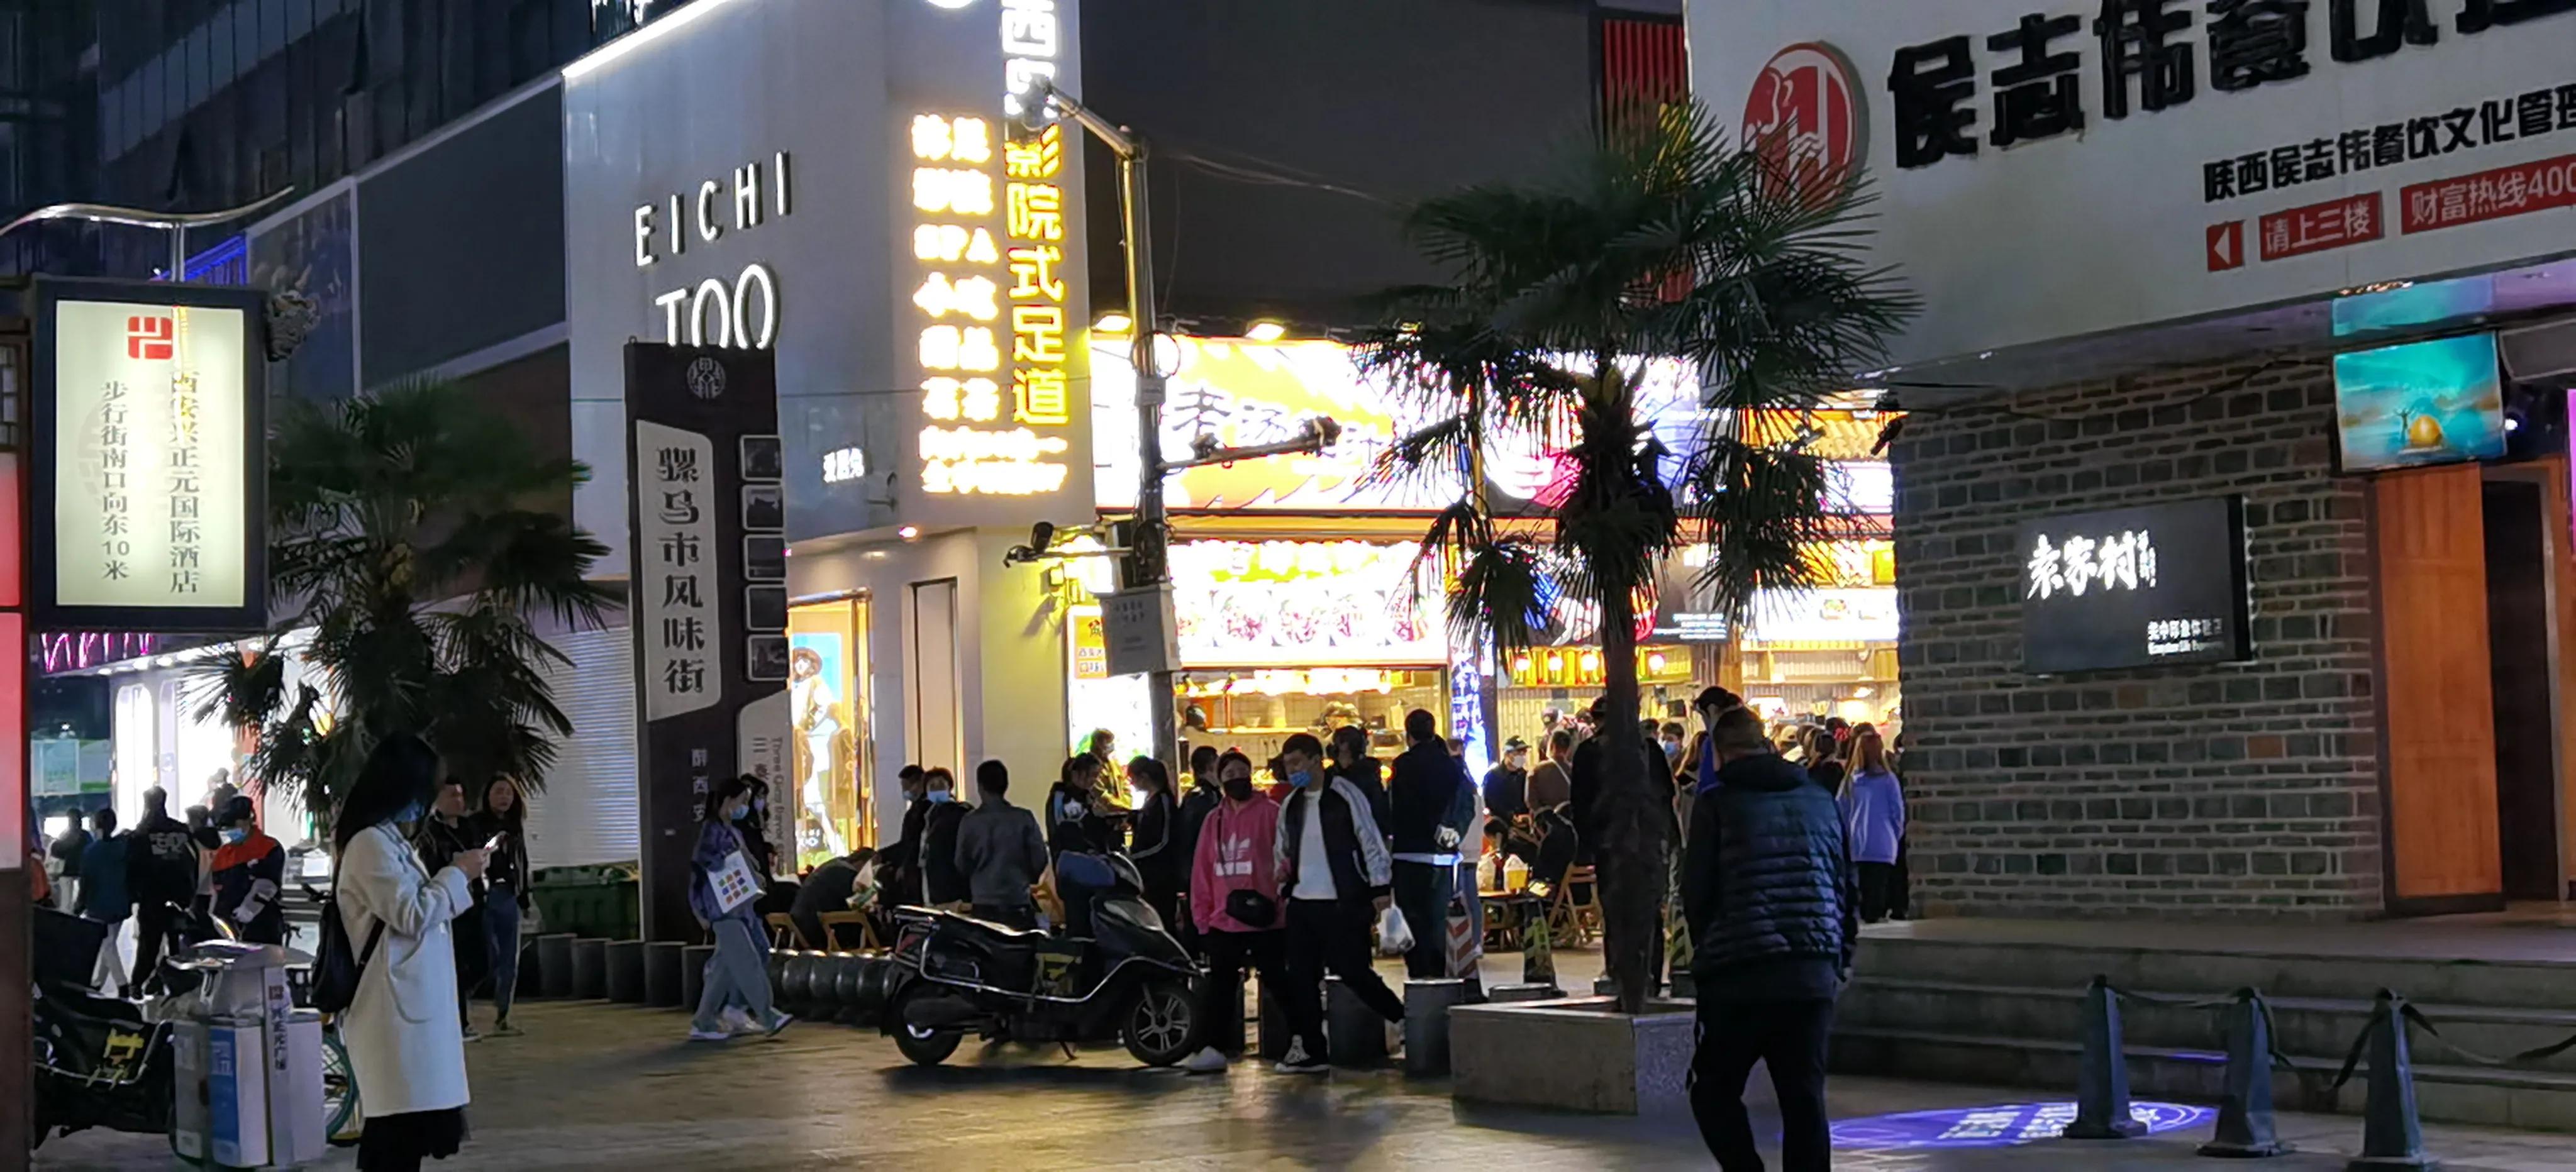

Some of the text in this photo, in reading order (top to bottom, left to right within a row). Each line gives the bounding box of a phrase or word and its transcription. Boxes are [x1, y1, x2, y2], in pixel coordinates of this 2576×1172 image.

[1888, 0, 2576, 169] 侯志伟餐
[635, 151, 789, 267] EICHI
[2265, 201, 2370, 253] 请上三楼
[655, 263, 779, 350] TOO
[101, 380, 130, 580] 步行街南口向东10米
[657, 446, 705, 695] 骡马市风味街
